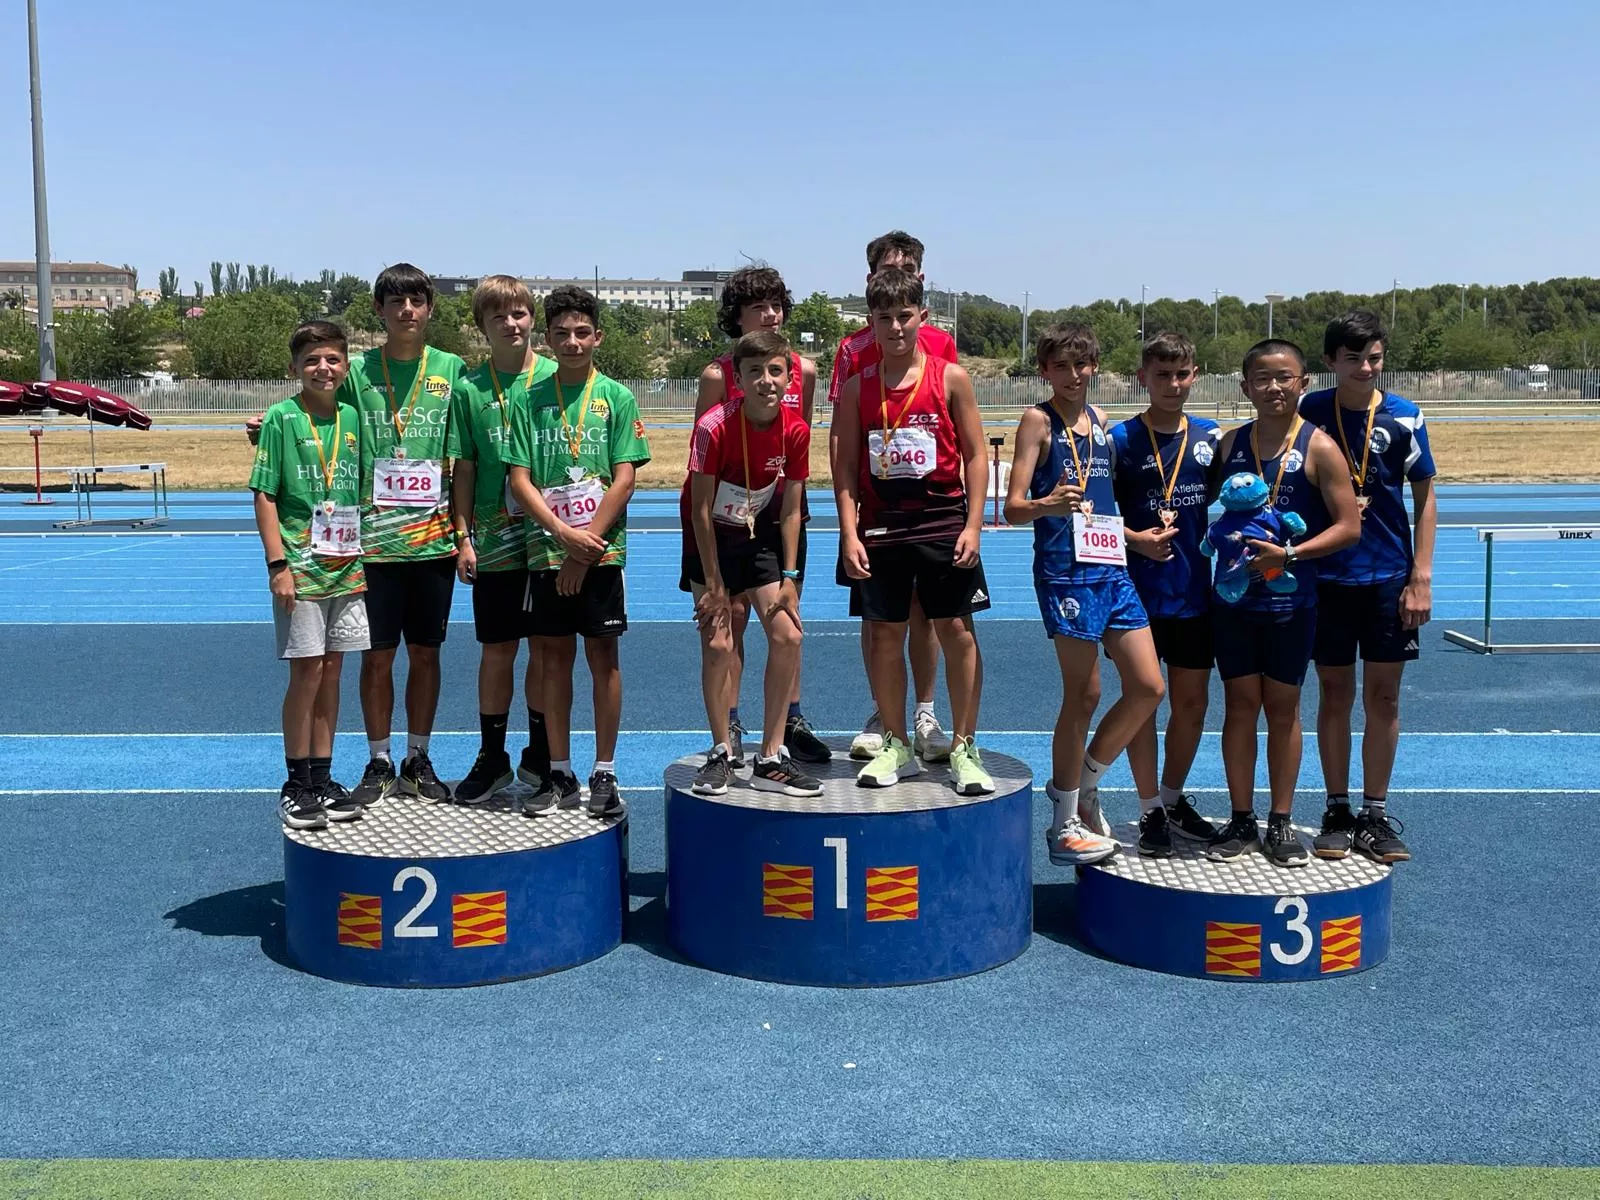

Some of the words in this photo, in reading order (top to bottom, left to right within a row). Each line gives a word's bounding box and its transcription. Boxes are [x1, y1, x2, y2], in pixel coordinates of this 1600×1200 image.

[908, 413, 940, 425] ZGZ
[880, 449, 926, 465] 046
[1065, 465, 1109, 480] Babastro
[383, 475, 432, 491] 1128
[551, 497, 597, 518] 1130
[1082, 531, 1118, 549] 1088
[1558, 530, 1592, 539] Vinex
[328, 626, 370, 638] adida
[823, 837, 848, 909] 1
[392, 866, 438, 937] 2
[1269, 895, 1313, 965] 3
